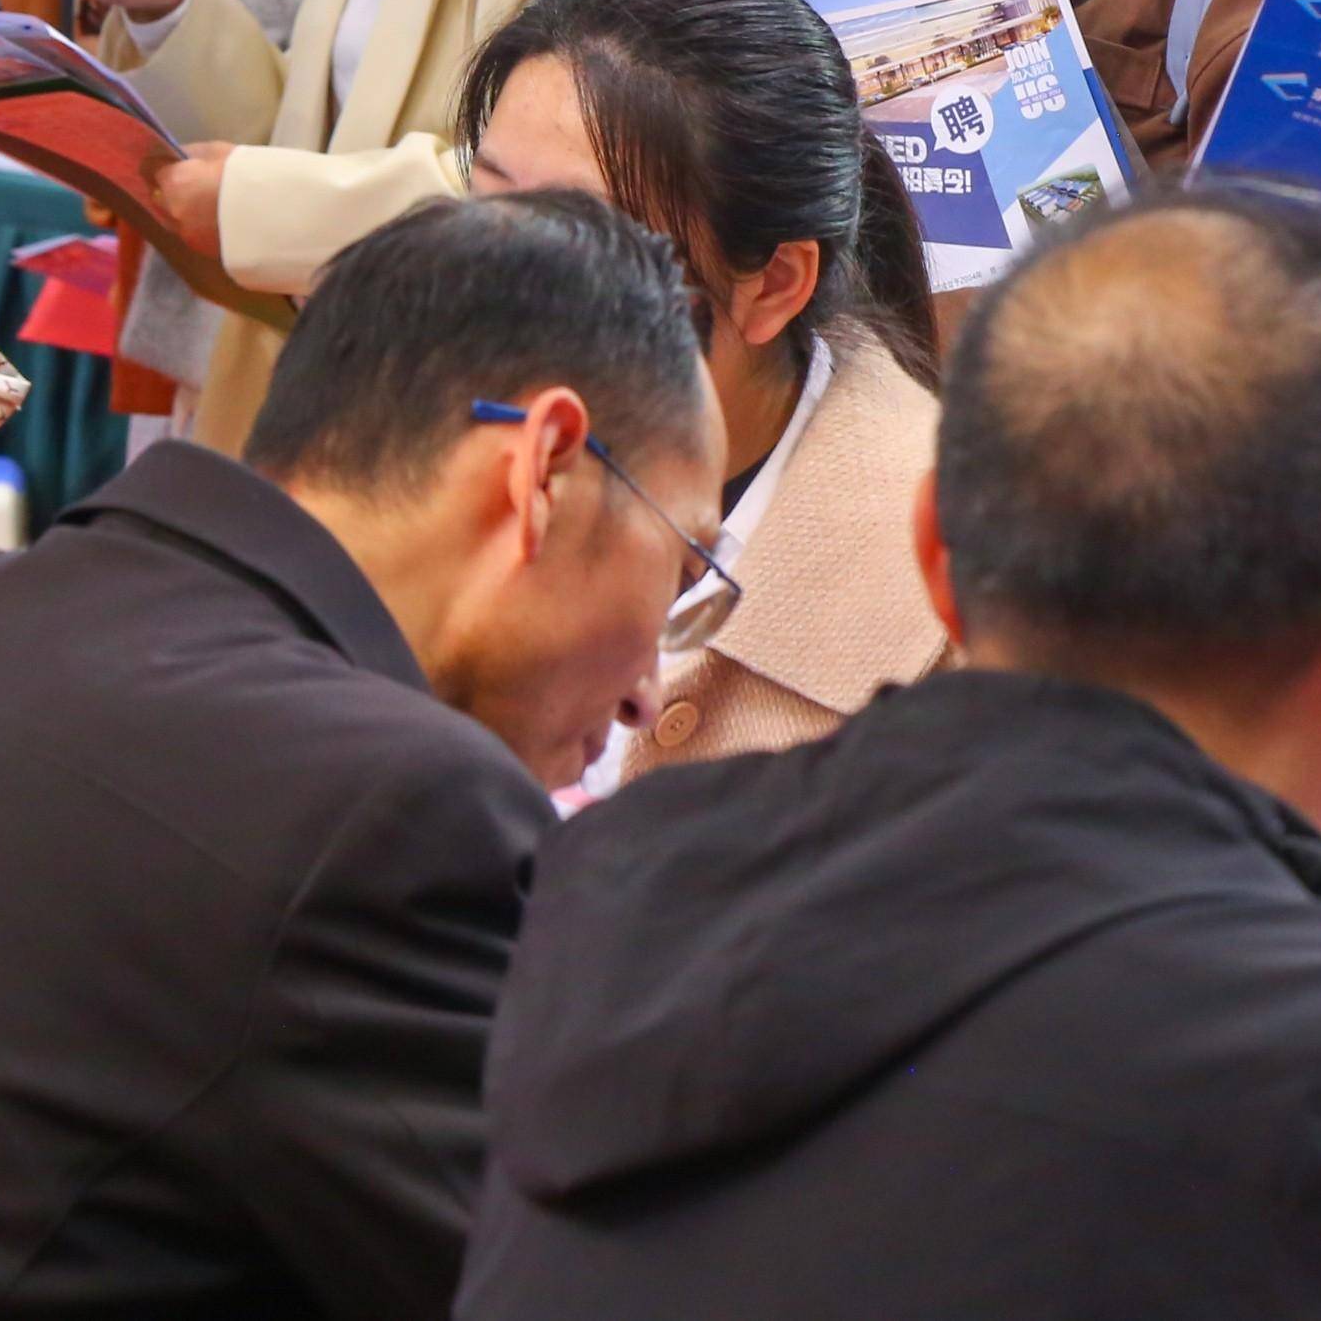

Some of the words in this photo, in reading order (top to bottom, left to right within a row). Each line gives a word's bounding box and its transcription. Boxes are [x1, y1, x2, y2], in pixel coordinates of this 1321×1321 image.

[1004, 37, 1051, 72] JOIN
[938, 95, 985, 142] 聘
[875, 134, 928, 164] ED
